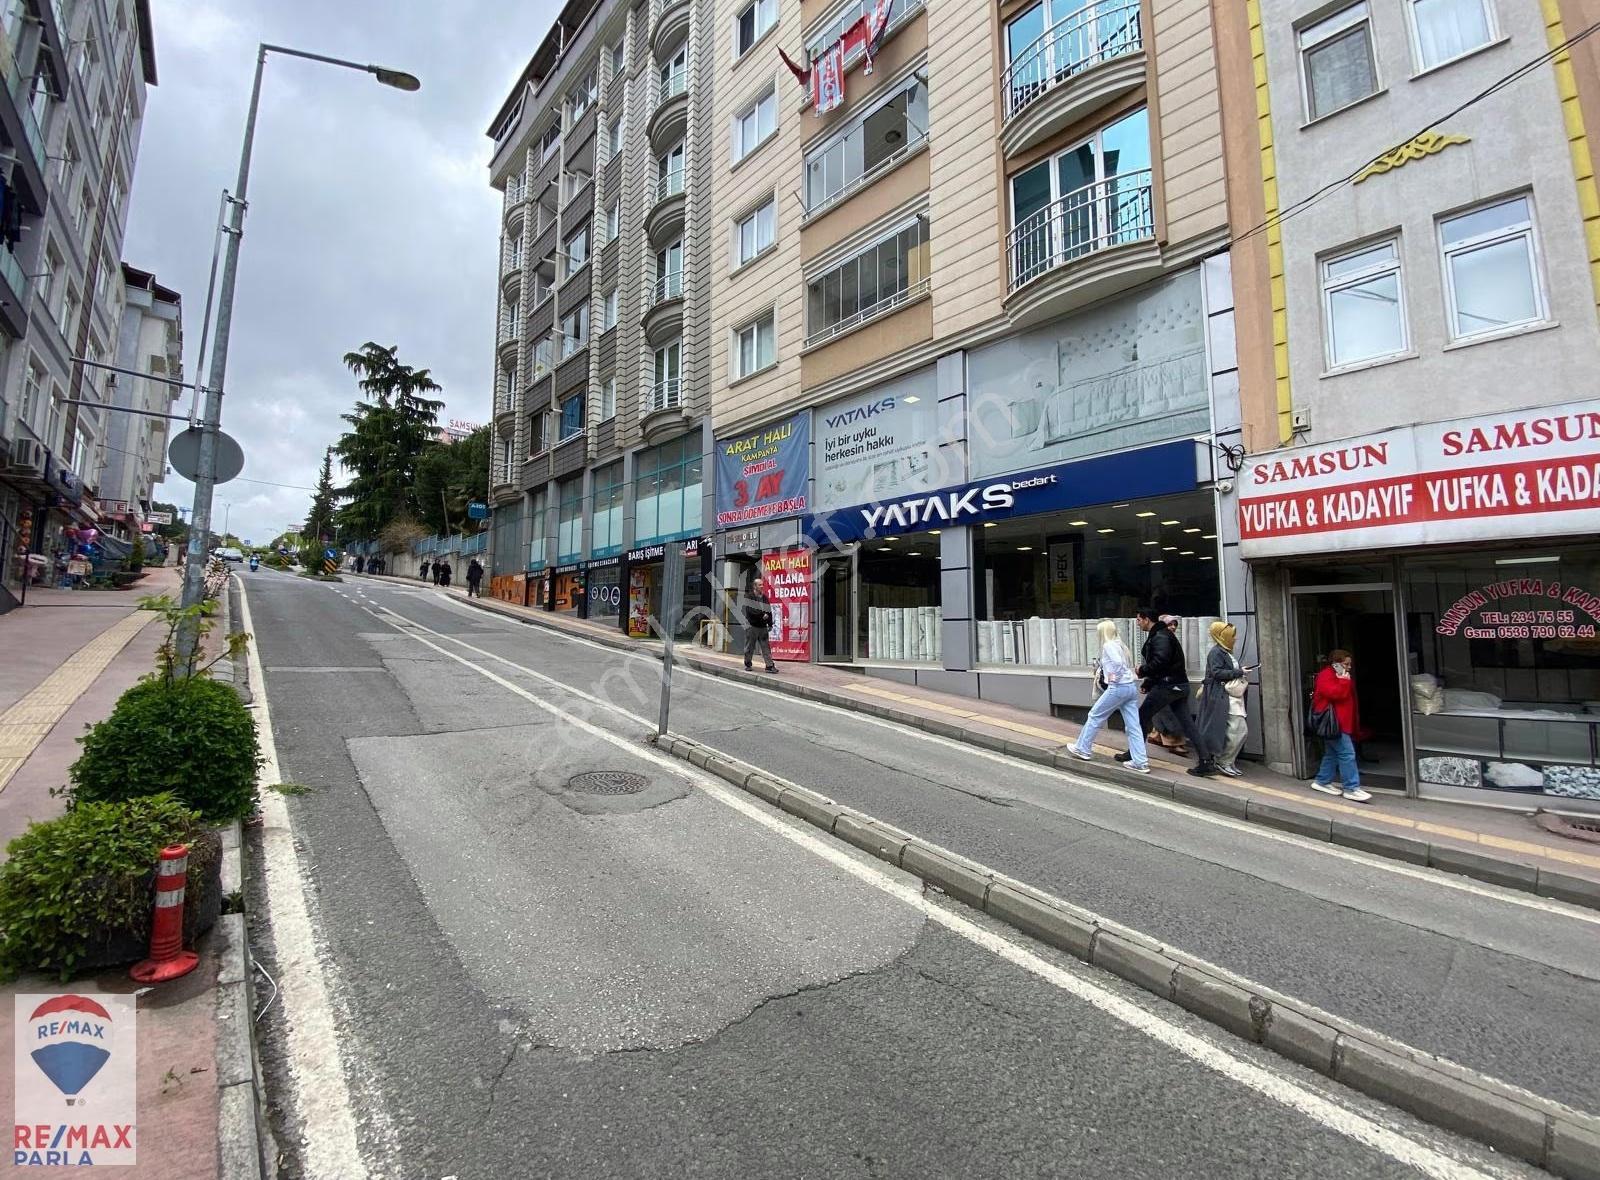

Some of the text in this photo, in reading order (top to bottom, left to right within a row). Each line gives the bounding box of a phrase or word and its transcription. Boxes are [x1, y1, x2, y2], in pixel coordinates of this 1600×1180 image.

[825, 397, 896, 429] YATAKS
[726, 423, 792, 456] ARAT HALI
[825, 427, 877, 452] İyi bir uyku
[825, 444, 864, 463] herkesin
[866, 436, 894, 453] hakkı
[741, 445, 779, 462] KAMPANYA
[1253, 442, 1388, 485] SAMSUN
[735, 469, 785, 507] 3 AY
[860, 474, 1058, 529] YATAKS bedart
[1425, 473, 1510, 513] YUFKA
[1514, 472, 1532, 506] &
[717, 497, 806, 524] SONRA ÖDEMEYE BAŞLA
[1241, 483, 1413, 532] YUFKA & KADAYIF
[628, 550, 644, 561] BARIŞ
[765, 556, 809, 571] ARAT HALI
[774, 572, 805, 585] ALANA
[774, 586, 808, 598] BEDAVA
[1436, 590, 1489, 636] SAMSUN
[1483, 578, 1543, 600] YUFKA
[1547, 582, 1561, 598] &
[1480, 610, 1574, 625] TEL: 234 75 55
[1464, 625, 1595, 639] Gsm: 0536 790 62 44
